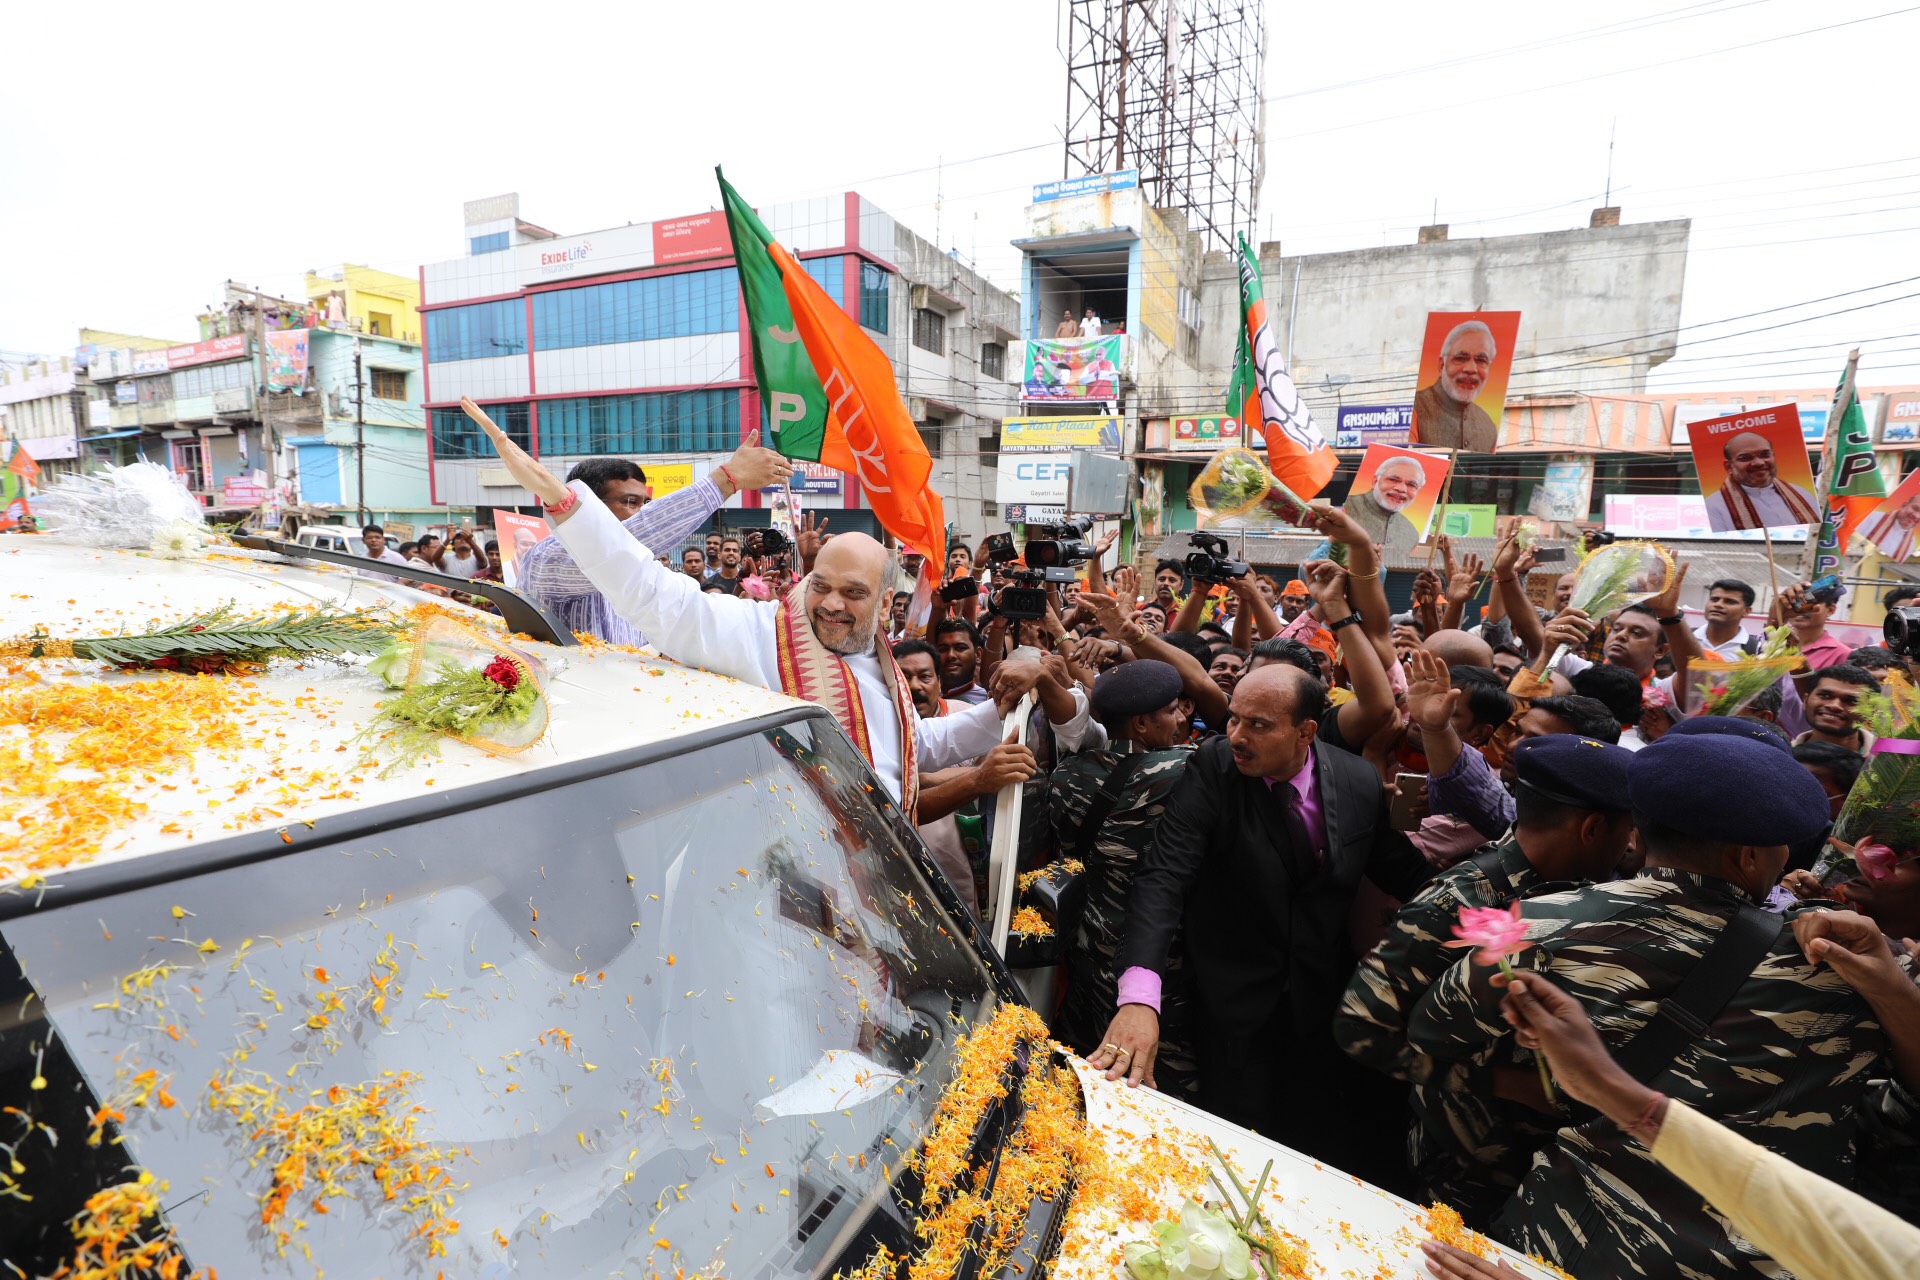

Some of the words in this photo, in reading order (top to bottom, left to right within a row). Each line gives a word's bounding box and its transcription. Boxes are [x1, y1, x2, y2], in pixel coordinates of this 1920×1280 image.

[542, 252, 567, 265] EXIDE
[568, 246, 587, 261] Life
[770, 391, 806, 432] P
[1343, 412, 1399, 427] ANSHUMAN
[1707, 414, 1776, 434] WELCOME
[1835, 452, 1877, 489] P
[505, 516, 541, 528] WELCOME
